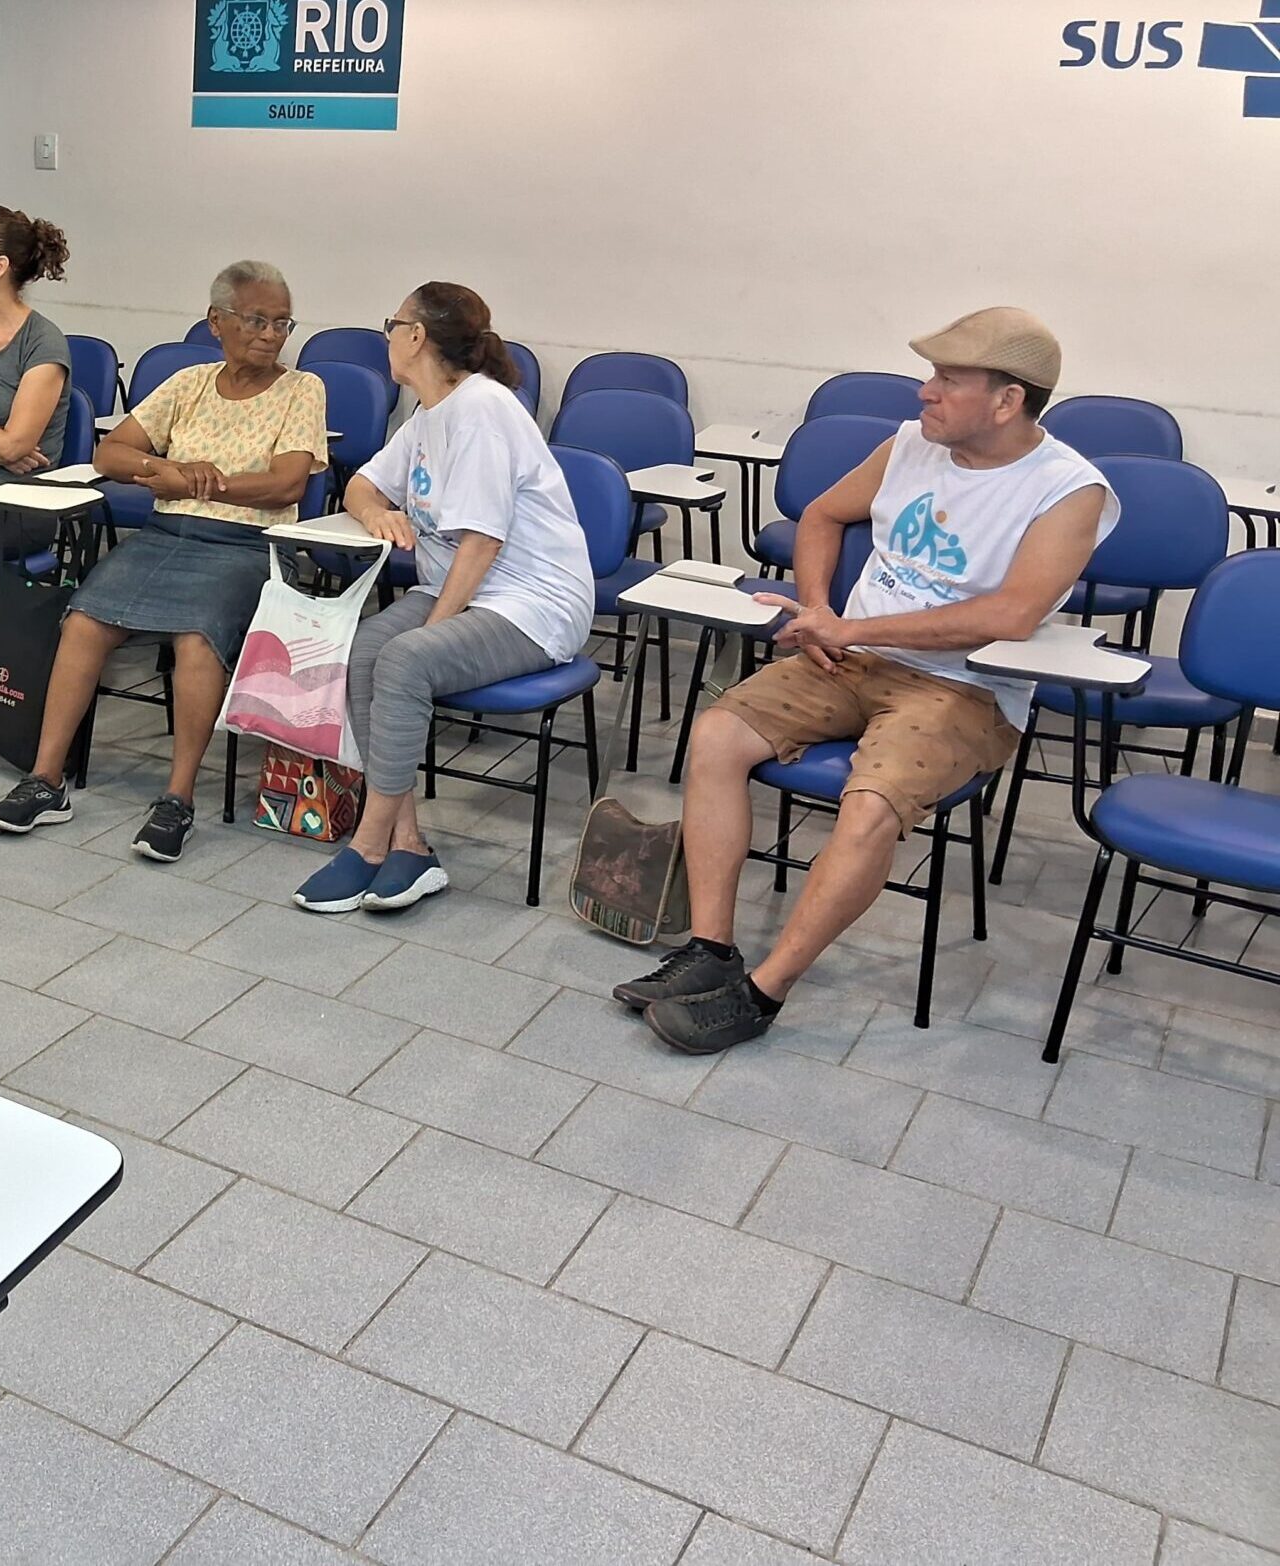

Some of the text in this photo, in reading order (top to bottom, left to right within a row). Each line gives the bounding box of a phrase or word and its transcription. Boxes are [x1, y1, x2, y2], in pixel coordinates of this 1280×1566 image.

[294, 0, 389, 53] RIO
[1059, 20, 1184, 69] SUS
[293, 58, 385, 73] PREFEITURA
[268, 101, 315, 120] SAÚDE
